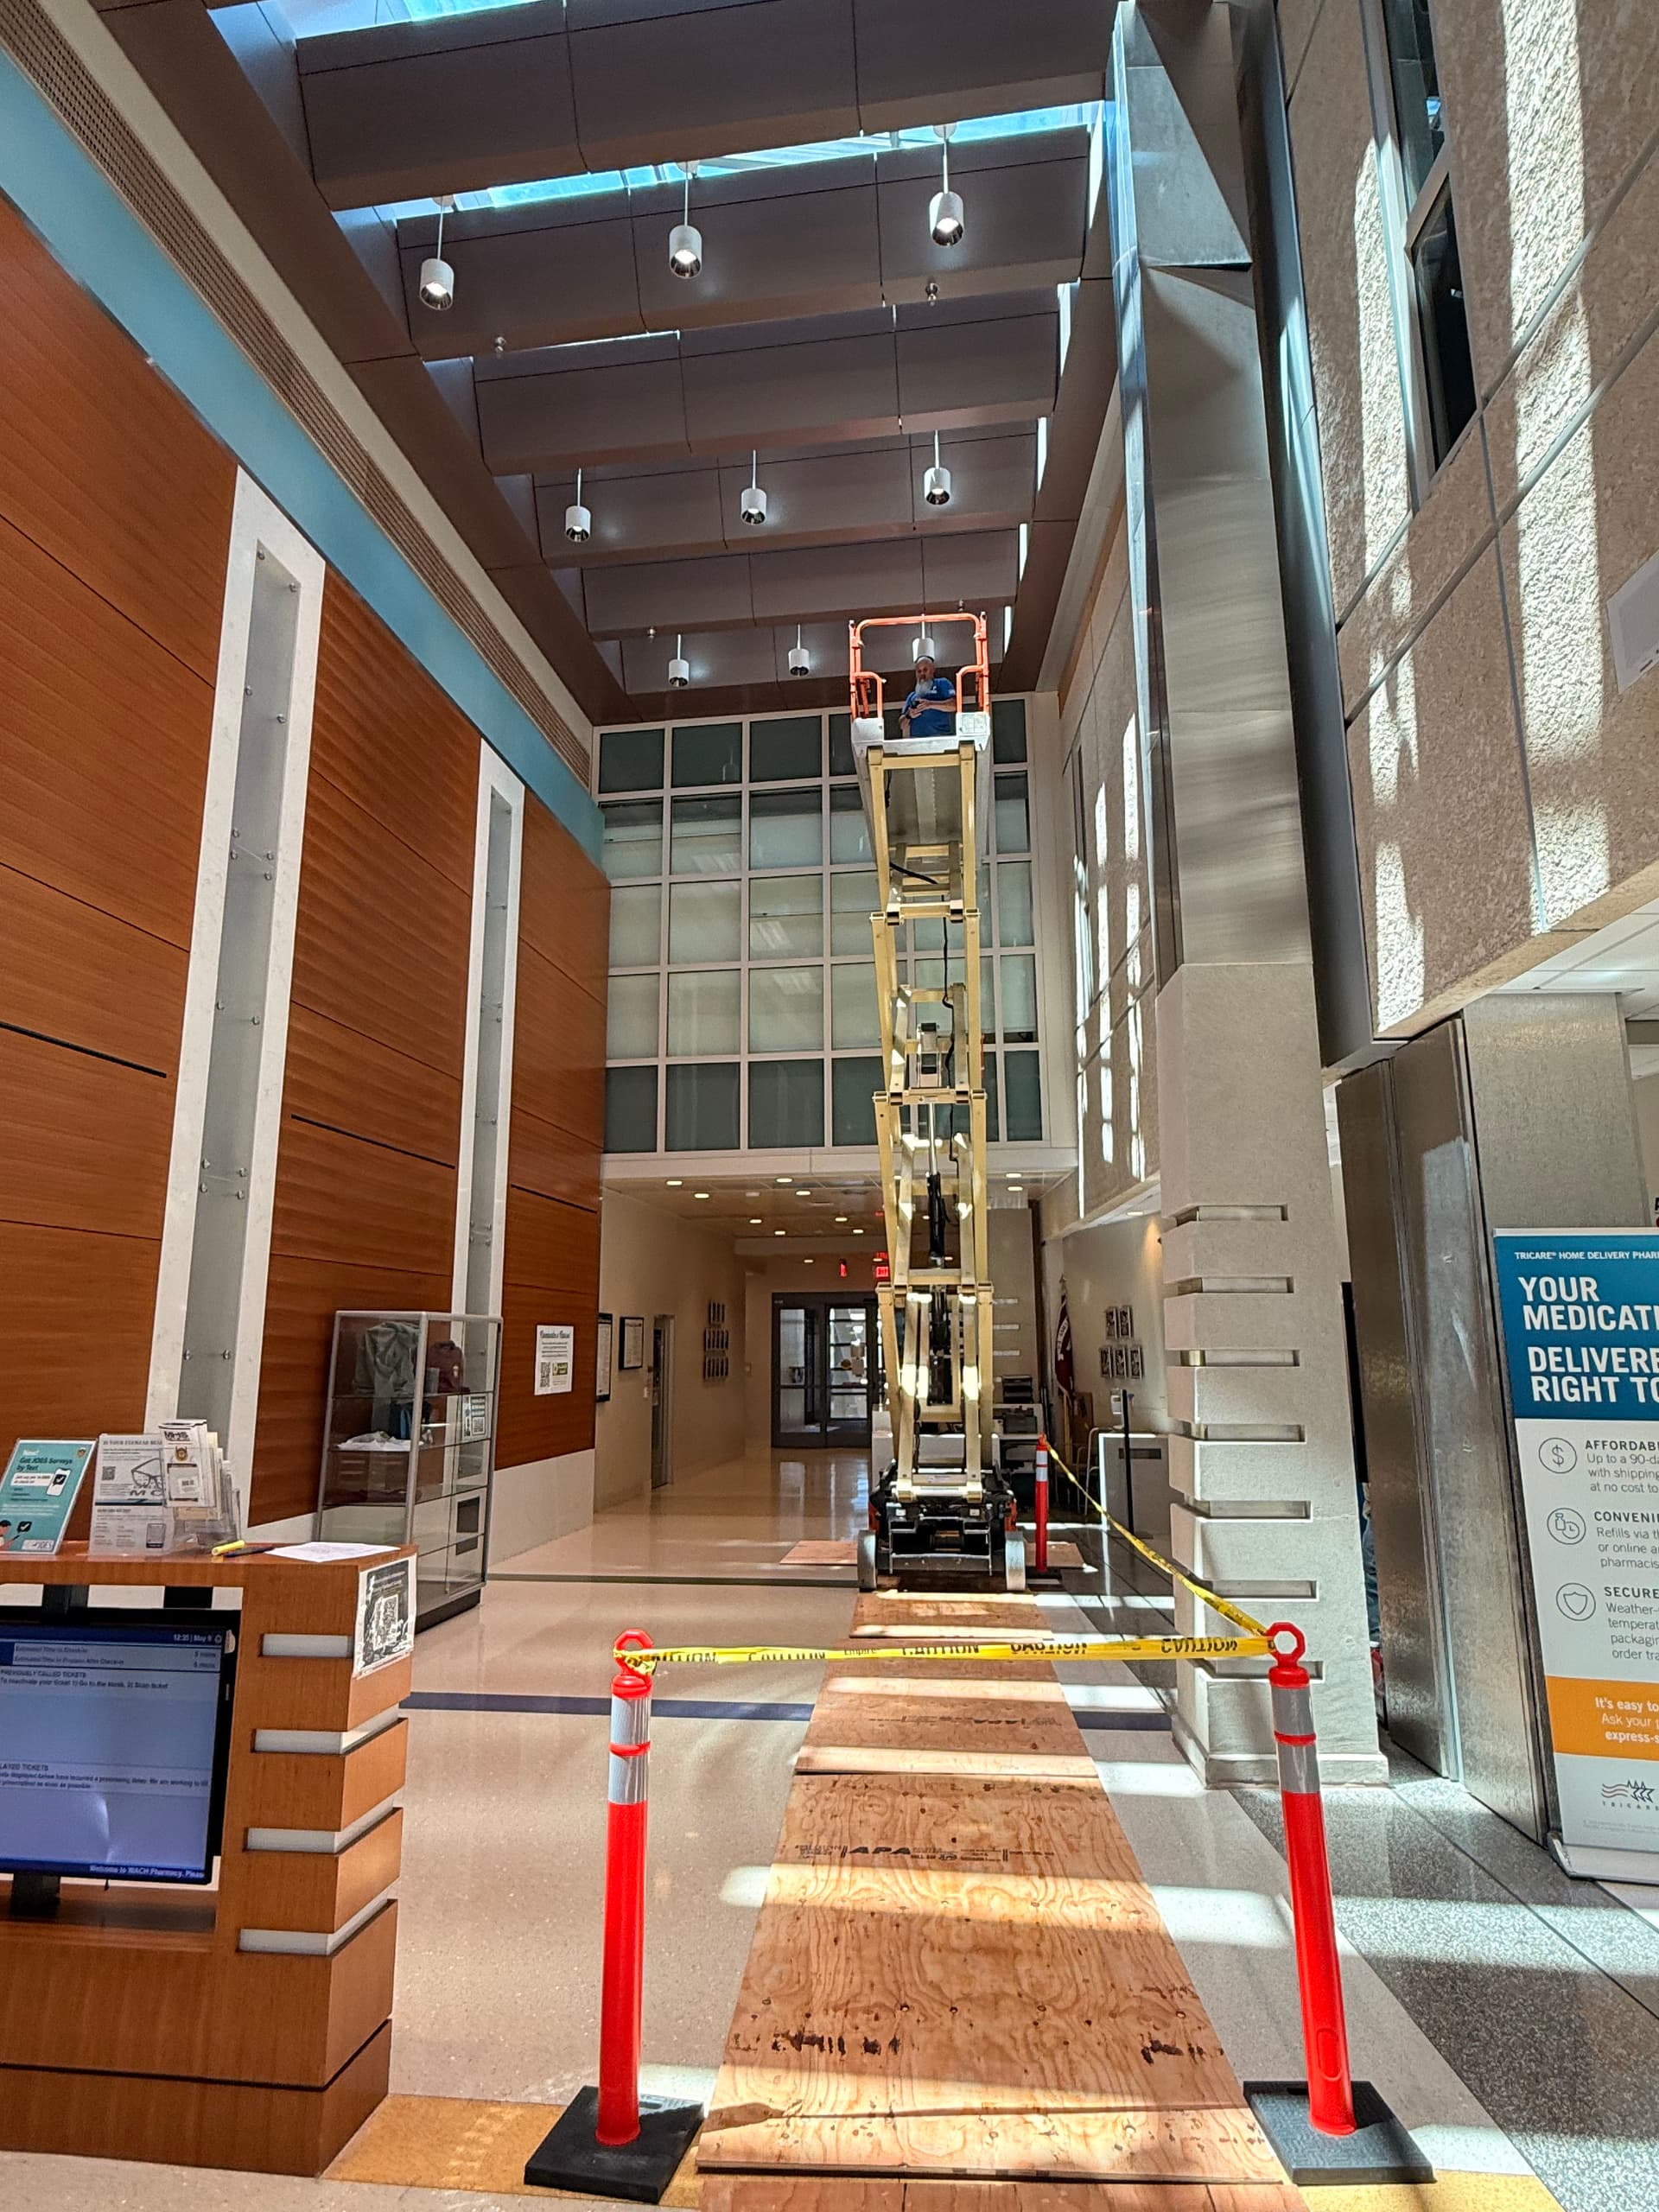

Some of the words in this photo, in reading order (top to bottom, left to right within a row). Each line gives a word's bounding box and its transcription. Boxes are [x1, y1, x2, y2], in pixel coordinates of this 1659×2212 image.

[1559, 1251, 1586, 1260] HOME
[1587, 1251, 1630, 1260] DELIVERY
[1632, 1251, 1659, 1260] PHAR
[1518, 1276, 1599, 1302] YOUR
[1531, 1376, 1620, 1402] RIGHT
[1586, 1440, 1659, 1451] AFFORDAB
[1587, 1452, 1603, 1465] Up
[1606, 1453, 1617, 1464] to
[1588, 1467, 1611, 1478] with
[1590, 1481, 1600, 1491] at
[1605, 1484, 1618, 1492] no
[1621, 1483, 1644, 1493] cost
[1648, 1483, 1659, 1493] to
[1597, 1527, 1630, 1538] Refills
[1633, 1530, 1649, 1539] via
[1613, 1543, 1647, 1554] online
[1600, 1557, 1659, 1569] pharmacis
[1604, 1586, 1659, 1599] SECURE
[1608, 1618, 1659, 1630] temperat
[1612, 1649, 1643, 1659] order
[1595, 1696, 1613, 1709] It's
[1617, 1700, 1643, 1713] easy
[1647, 1700, 1659, 1712] to
[1602, 1713, 1623, 1726] Ask
[1625, 1717, 1651, 1728] your
